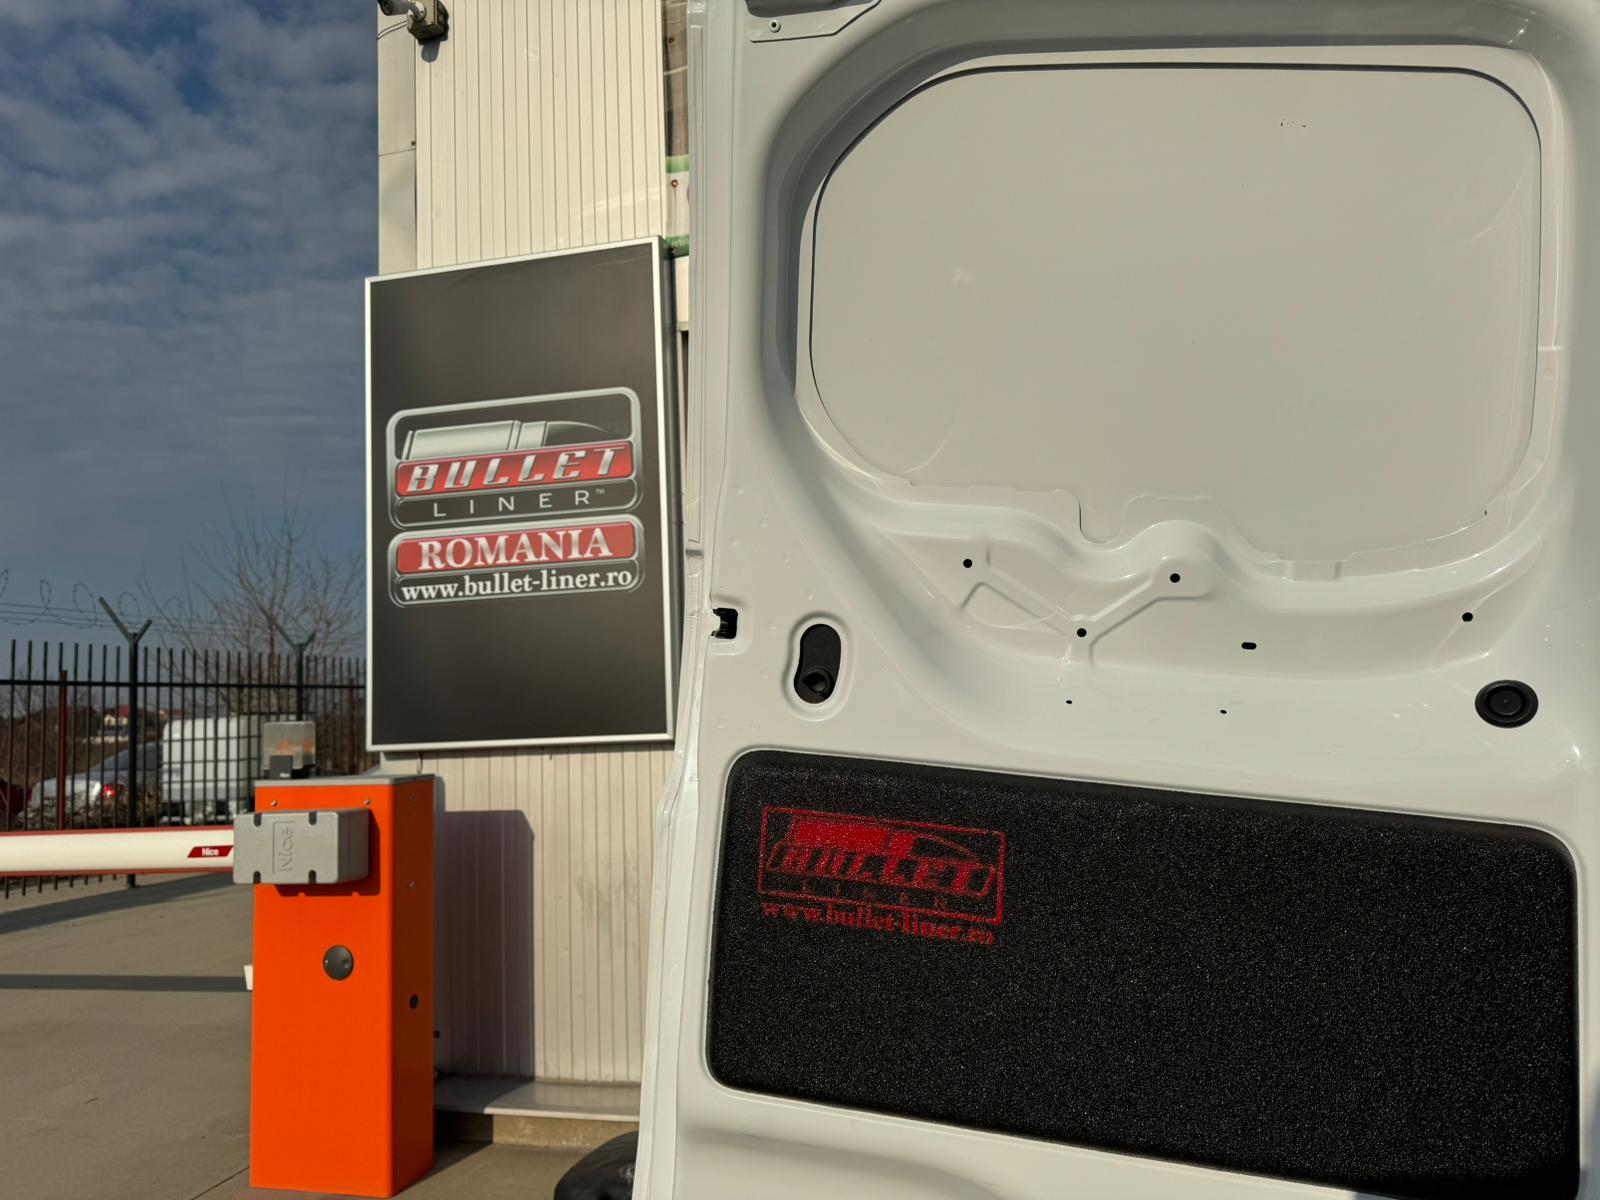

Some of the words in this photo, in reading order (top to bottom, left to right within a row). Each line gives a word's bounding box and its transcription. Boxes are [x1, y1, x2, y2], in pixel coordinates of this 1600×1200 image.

[407, 446, 625, 492] BULLET
[434, 490, 590, 517] LINER
[418, 527, 613, 570] ROMANIA
[401, 569, 632, 601] www.bullet-liner.ro
[202, 848, 219, 857] Nice
[278, 826, 293, 872] Nice
